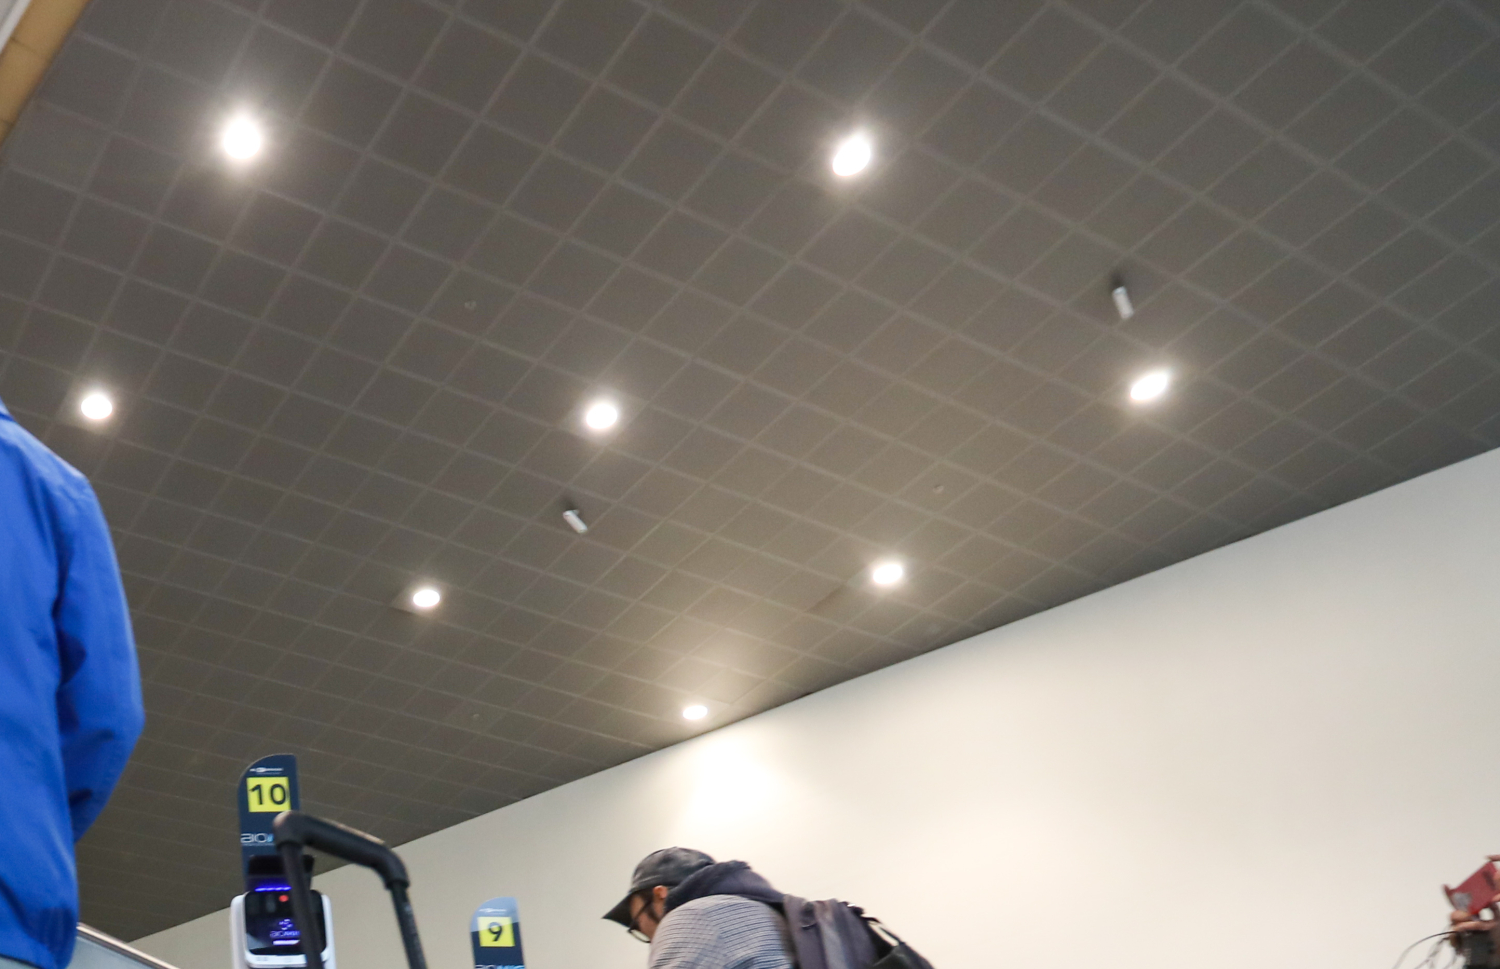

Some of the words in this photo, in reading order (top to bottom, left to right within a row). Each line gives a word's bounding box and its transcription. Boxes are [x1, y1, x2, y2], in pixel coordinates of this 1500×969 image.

[249, 784, 286, 805] 10
[240, 833, 274, 843] BIO
[487, 921, 503, 942] 9
